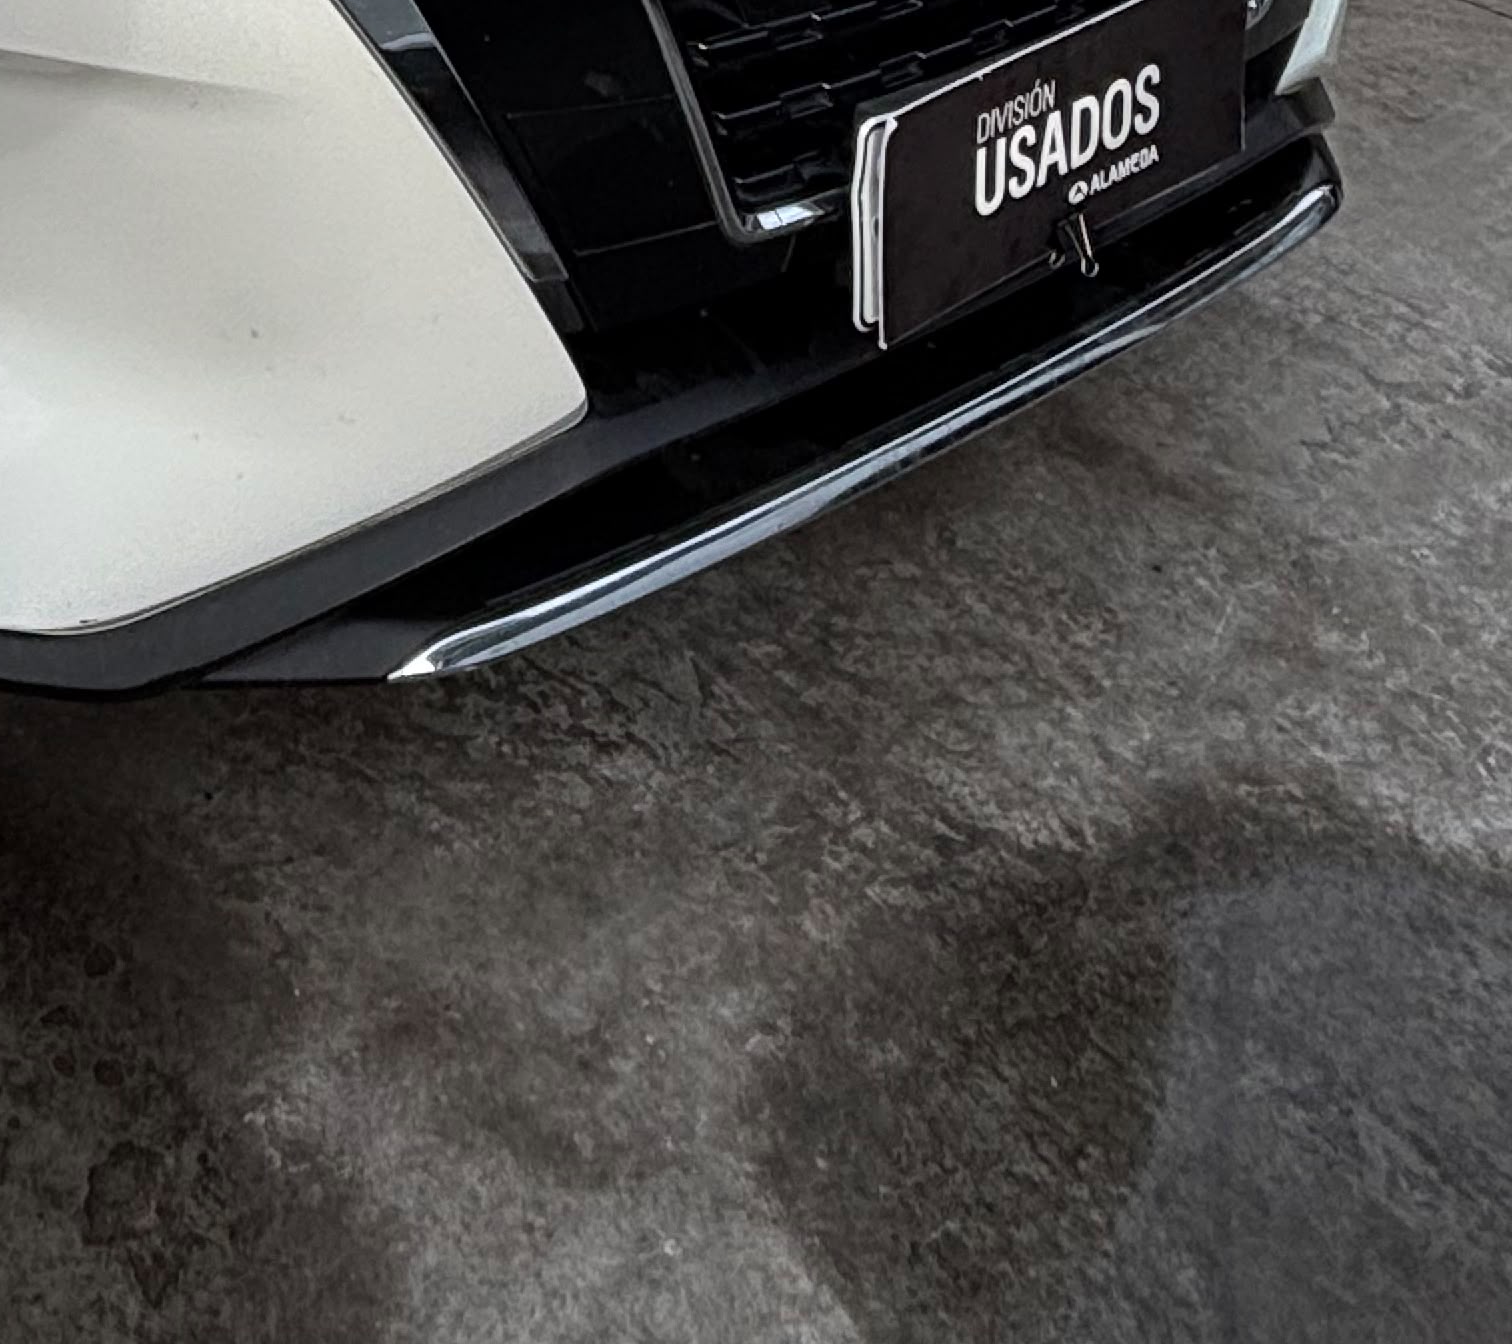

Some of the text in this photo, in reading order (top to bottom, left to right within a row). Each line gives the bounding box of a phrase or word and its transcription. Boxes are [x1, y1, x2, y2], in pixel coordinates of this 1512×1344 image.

[975, 64, 1160, 216] USADOS
[976, 78, 1056, 144] DIVISIÓN
[1088, 144, 1160, 195] ALAMEDA
